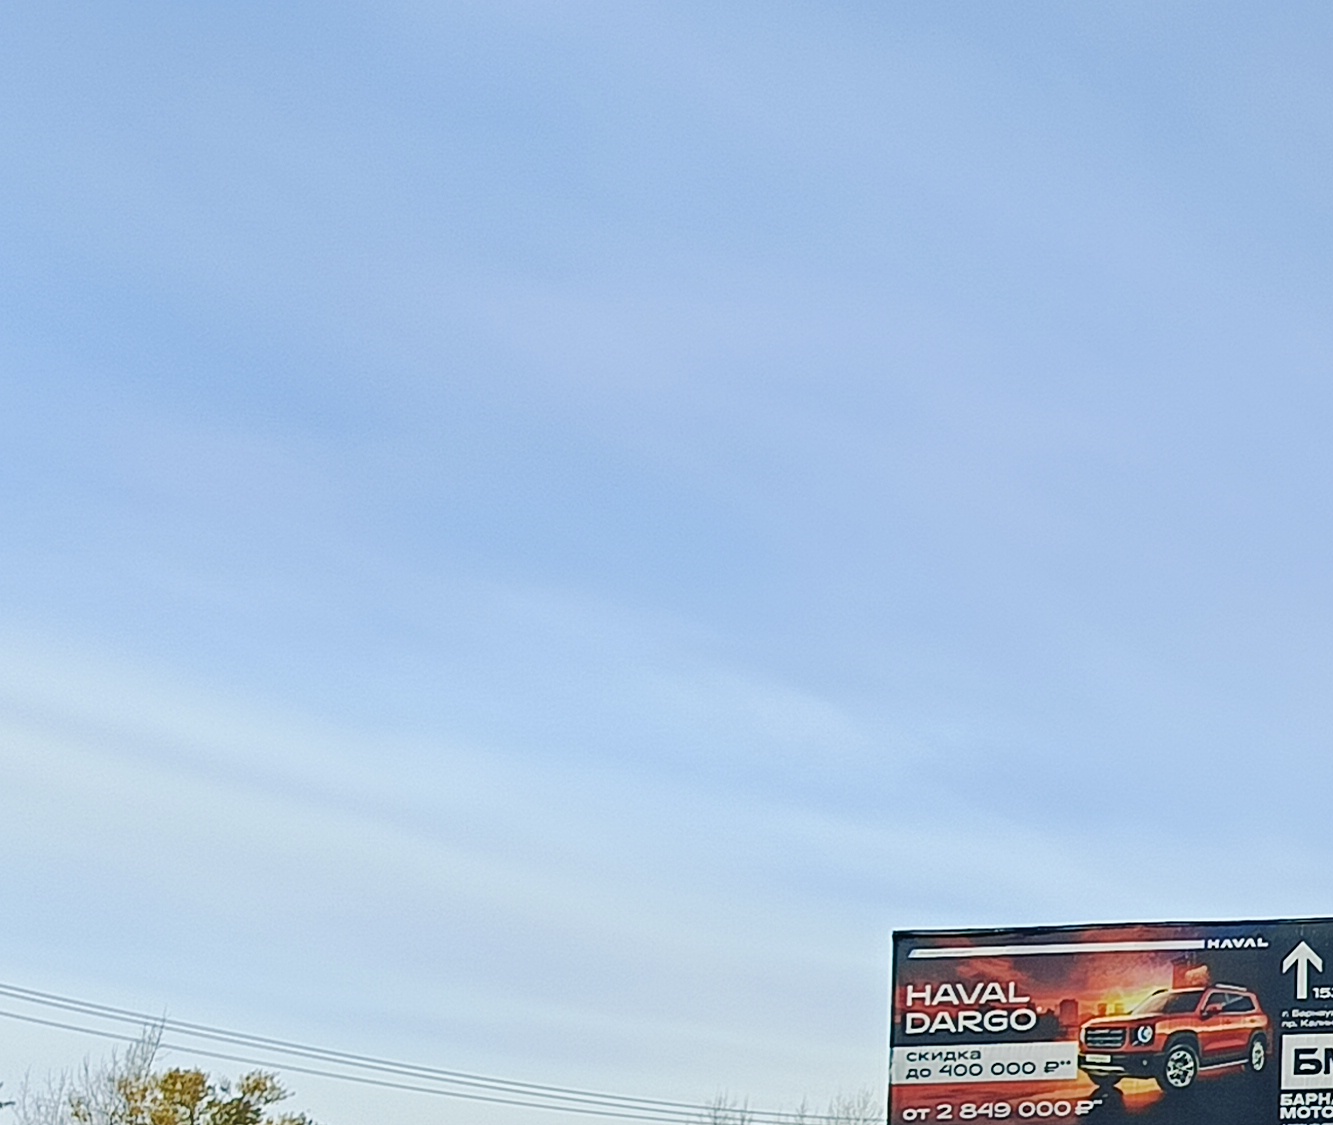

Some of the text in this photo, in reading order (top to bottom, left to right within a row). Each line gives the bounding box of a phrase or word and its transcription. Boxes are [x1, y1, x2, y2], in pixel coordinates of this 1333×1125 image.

[1207, 938, 1269, 949] HAVAL
[906, 981, 1031, 1007] HAVAL
[905, 1008, 1037, 1034] DARGO
[906, 1050, 981, 1062] скидка
[905, 1068, 932, 1079] до
[938, 1063, 983, 1077] 400
[991, 1061, 1036, 1075] 000
[902, 1108, 931, 1121] от
[936, 1104, 953, 1120] 2
[959, 1102, 1011, 1119] 849
[1018, 1101, 1072, 1117] 000
